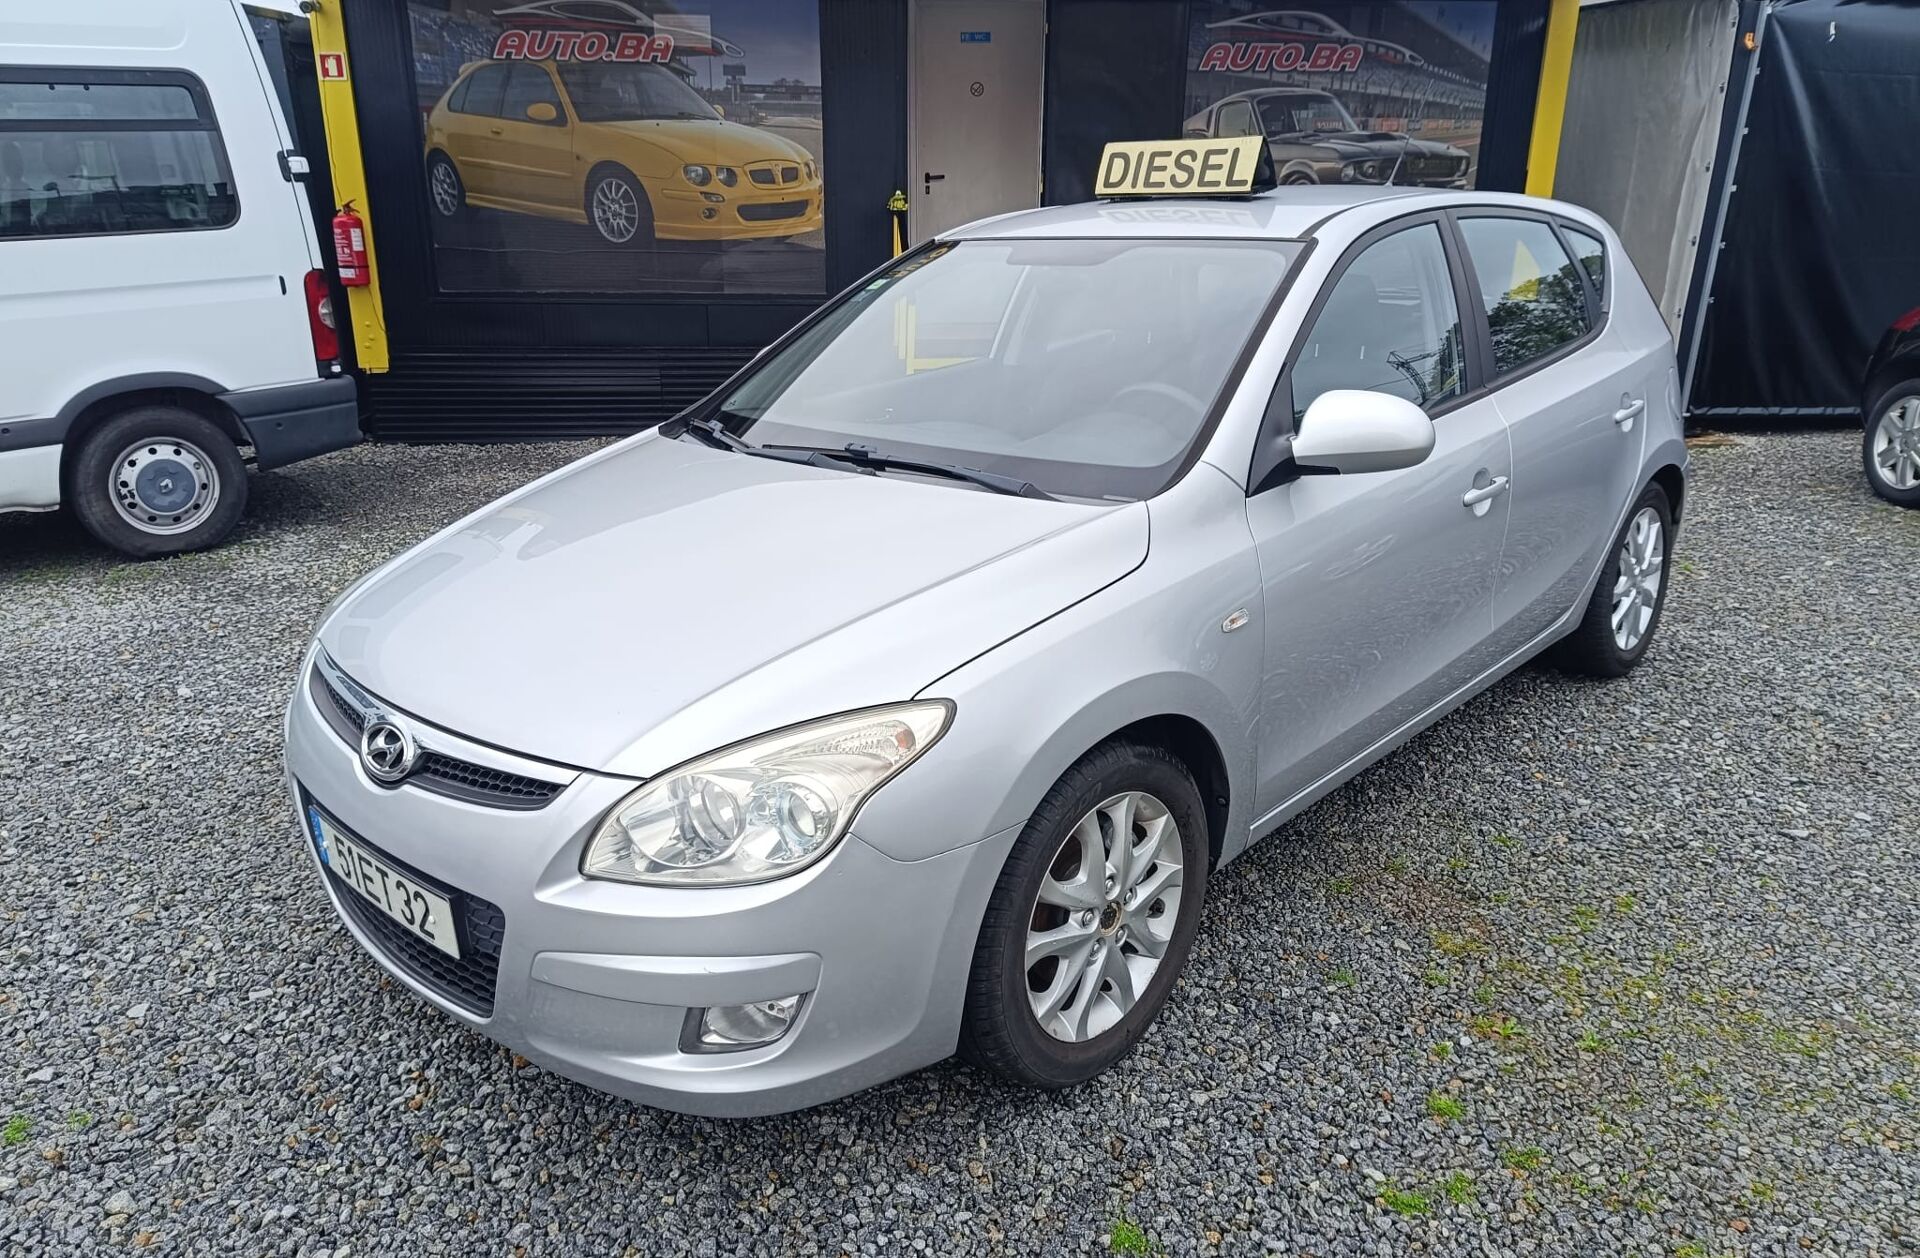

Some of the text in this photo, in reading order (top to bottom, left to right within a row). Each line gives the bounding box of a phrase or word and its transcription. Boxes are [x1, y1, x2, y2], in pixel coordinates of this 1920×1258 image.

[493, 30, 675, 64] AUTO.BA
[1199, 42, 1363, 72] AUTO.BA
[1102, 147, 1249, 189] DIESEL
